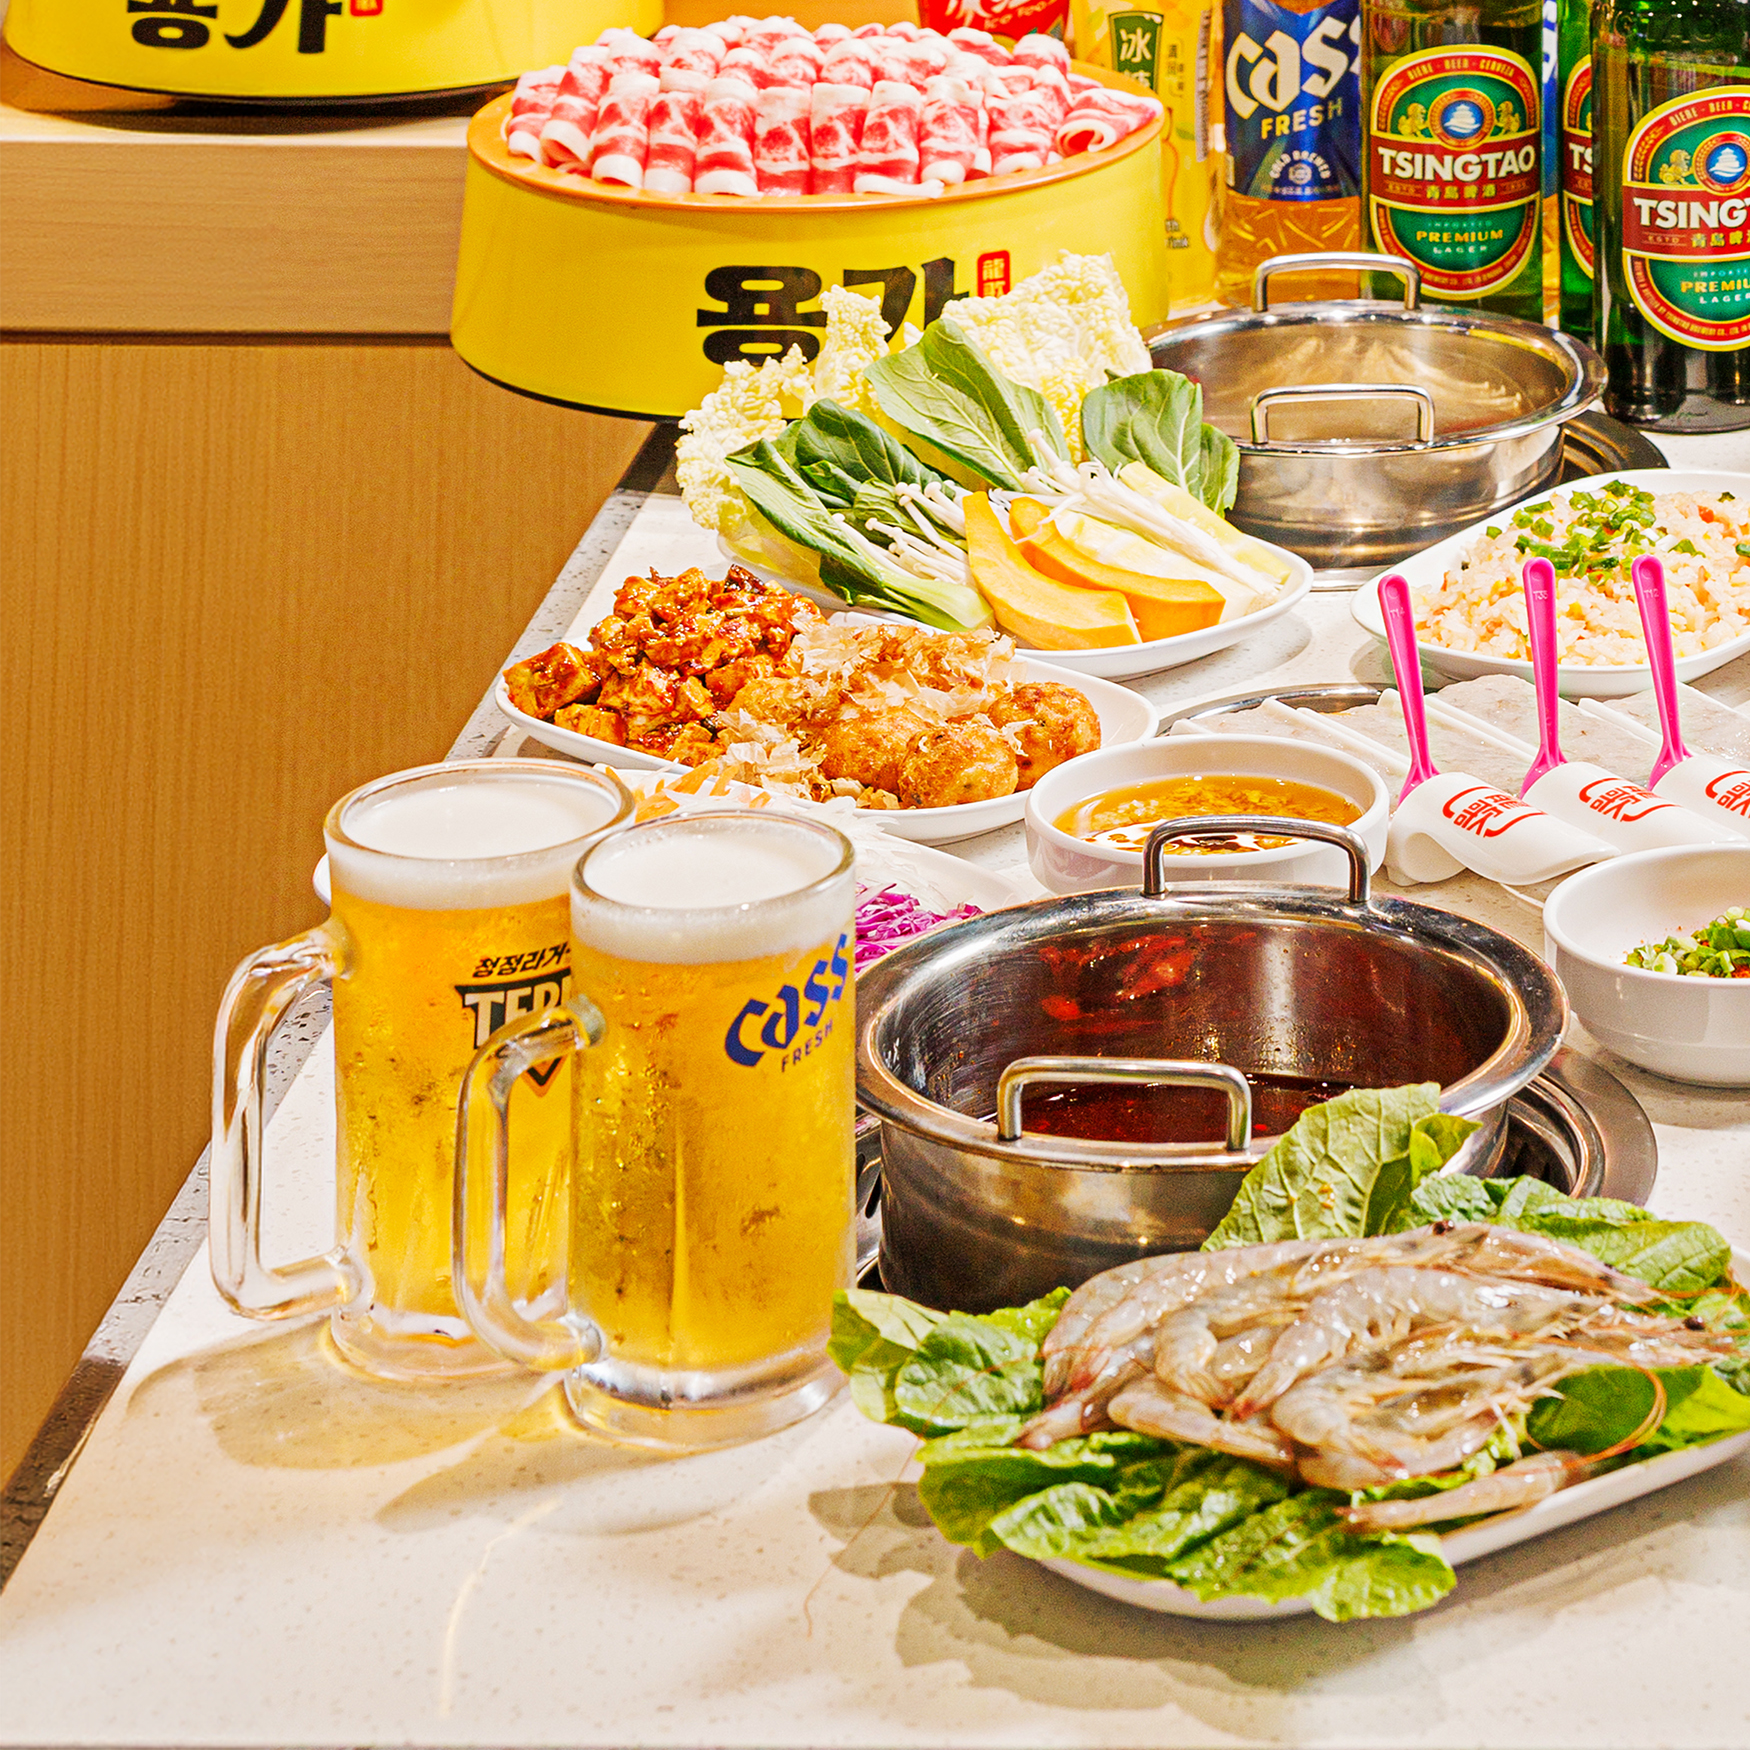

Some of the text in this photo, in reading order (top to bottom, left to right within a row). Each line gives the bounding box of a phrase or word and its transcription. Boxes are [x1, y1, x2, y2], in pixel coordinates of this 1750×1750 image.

[1261, 97, 1343, 141] FRESH
[1378, 145, 1535, 182] TSINGTAO
[1416, 229, 1503, 243] PREMIUM
[1433, 246, 1487, 254] LAGER
[781, 1018, 834, 1073] FRESH
